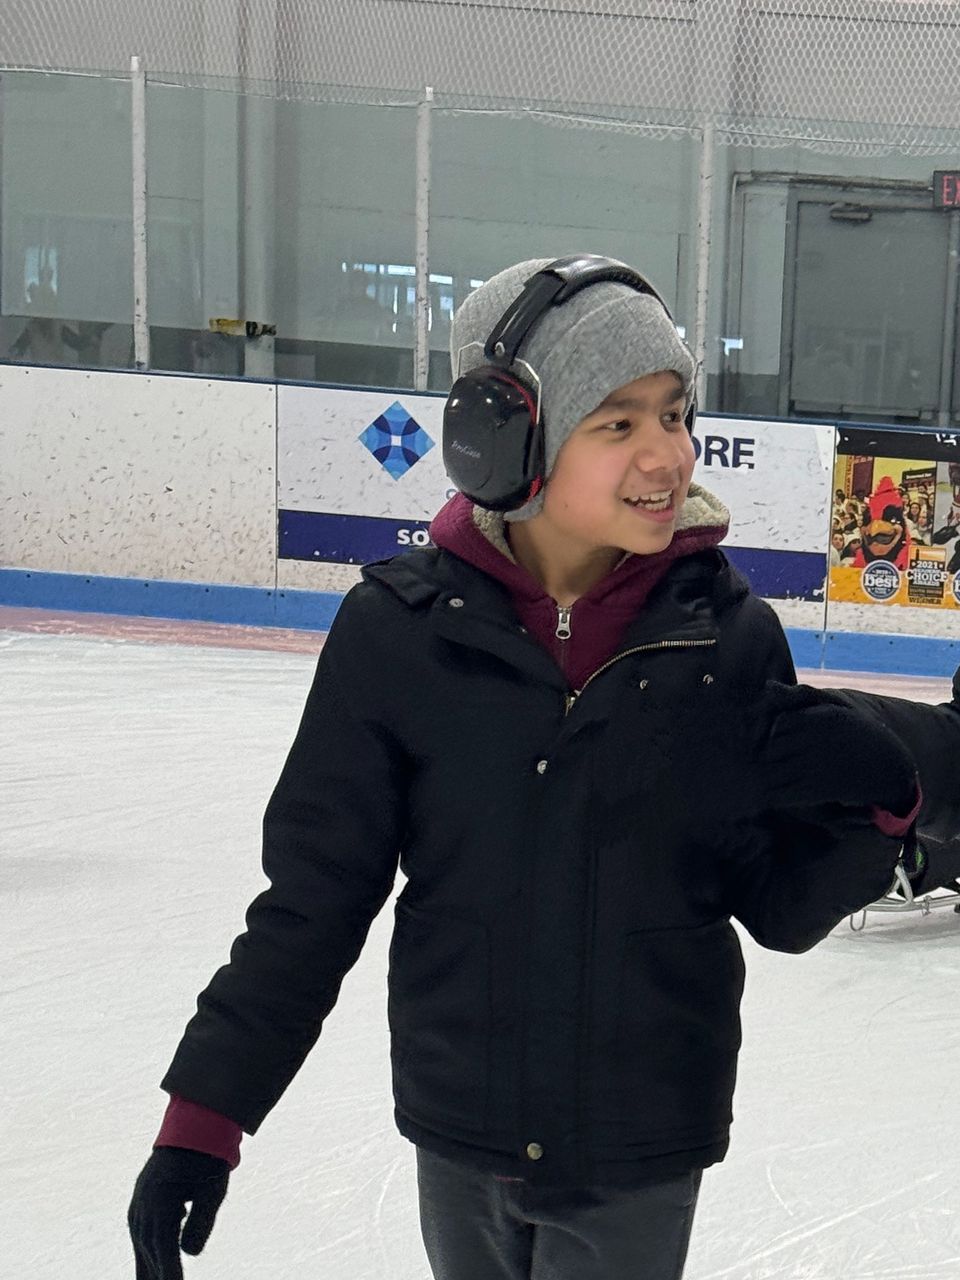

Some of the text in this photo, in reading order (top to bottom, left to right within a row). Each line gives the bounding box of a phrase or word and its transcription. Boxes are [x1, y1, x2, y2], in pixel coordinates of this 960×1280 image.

[916, 560, 938, 569] 2021
[864, 573, 899, 589] best
[905, 569, 950, 583] CHOICE
